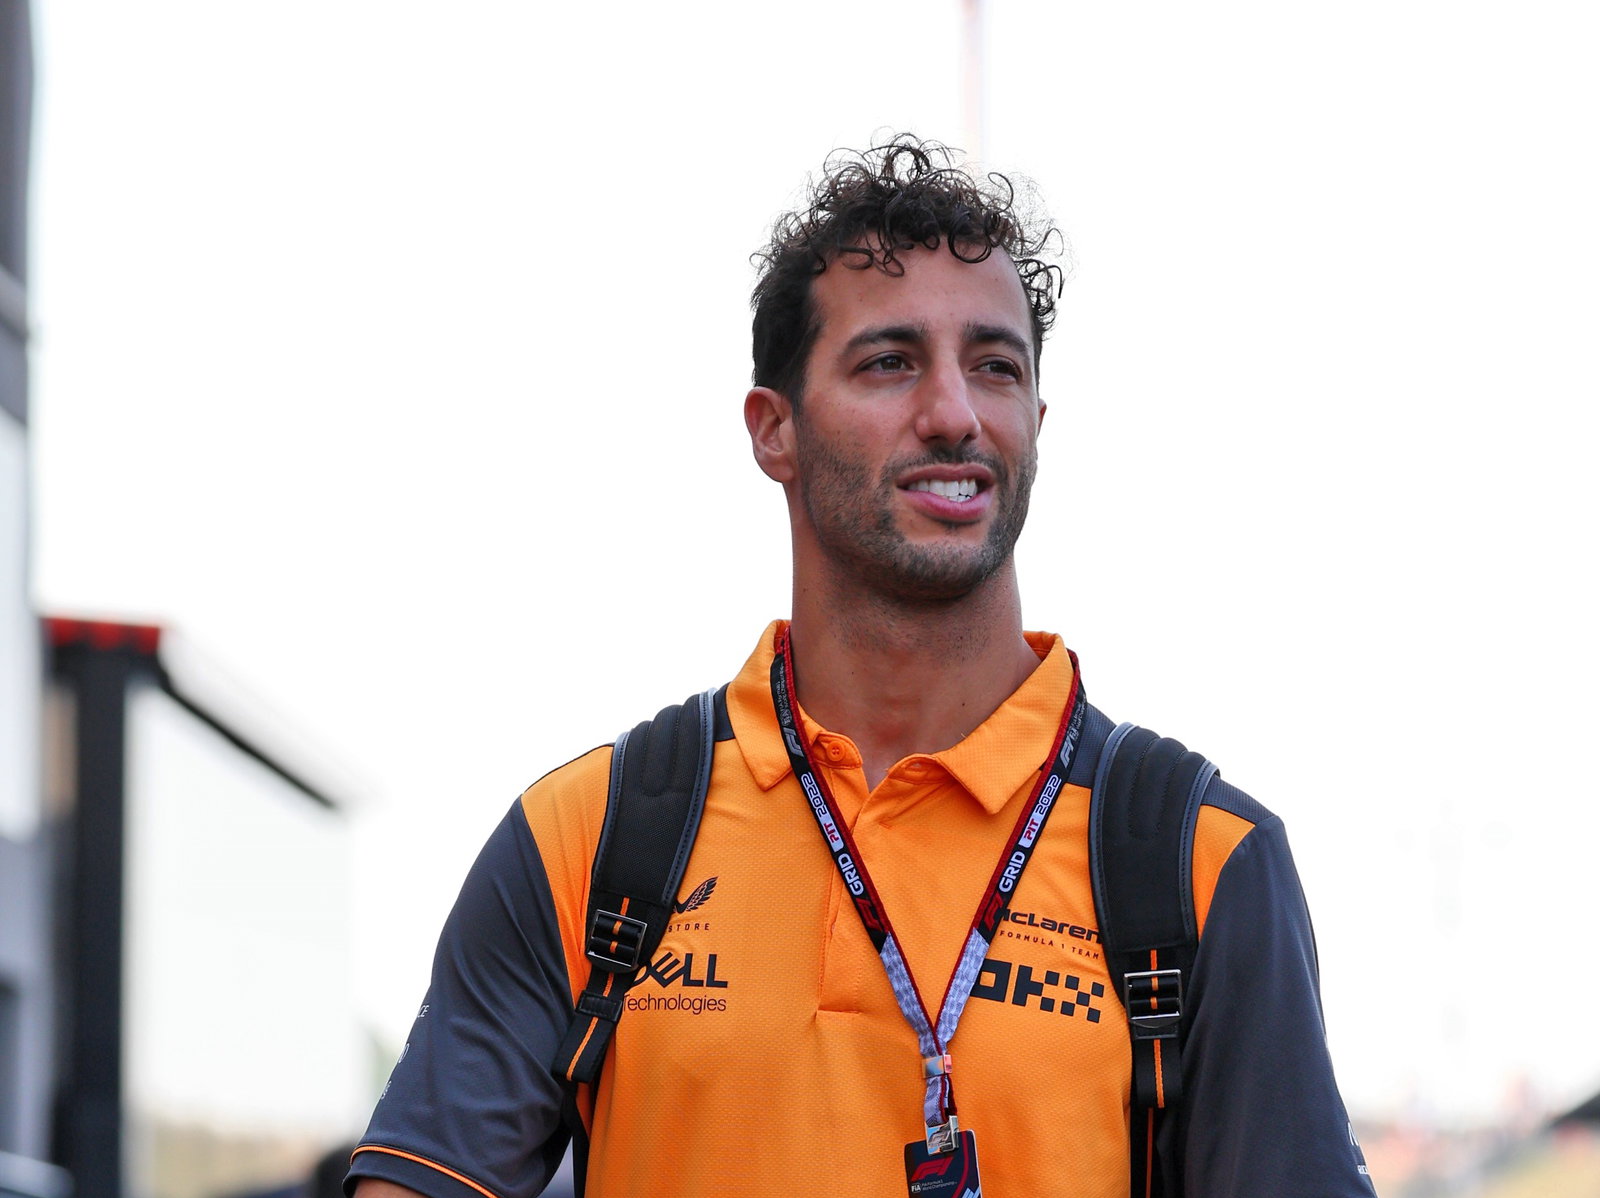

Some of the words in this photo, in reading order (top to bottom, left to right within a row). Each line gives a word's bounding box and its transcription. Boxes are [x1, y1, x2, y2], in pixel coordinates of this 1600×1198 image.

[801, 772, 828, 817] 2022
[824, 822, 839, 843] PIT
[999, 851, 1025, 892] GRID
[1023, 818, 1039, 840] PIT
[1035, 775, 1061, 815] 2022
[838, 853, 864, 896] GRID
[668, 923, 710, 933] STORE
[1000, 930, 1054, 947] FORMULA
[1072, 947, 1099, 959] TEAM
